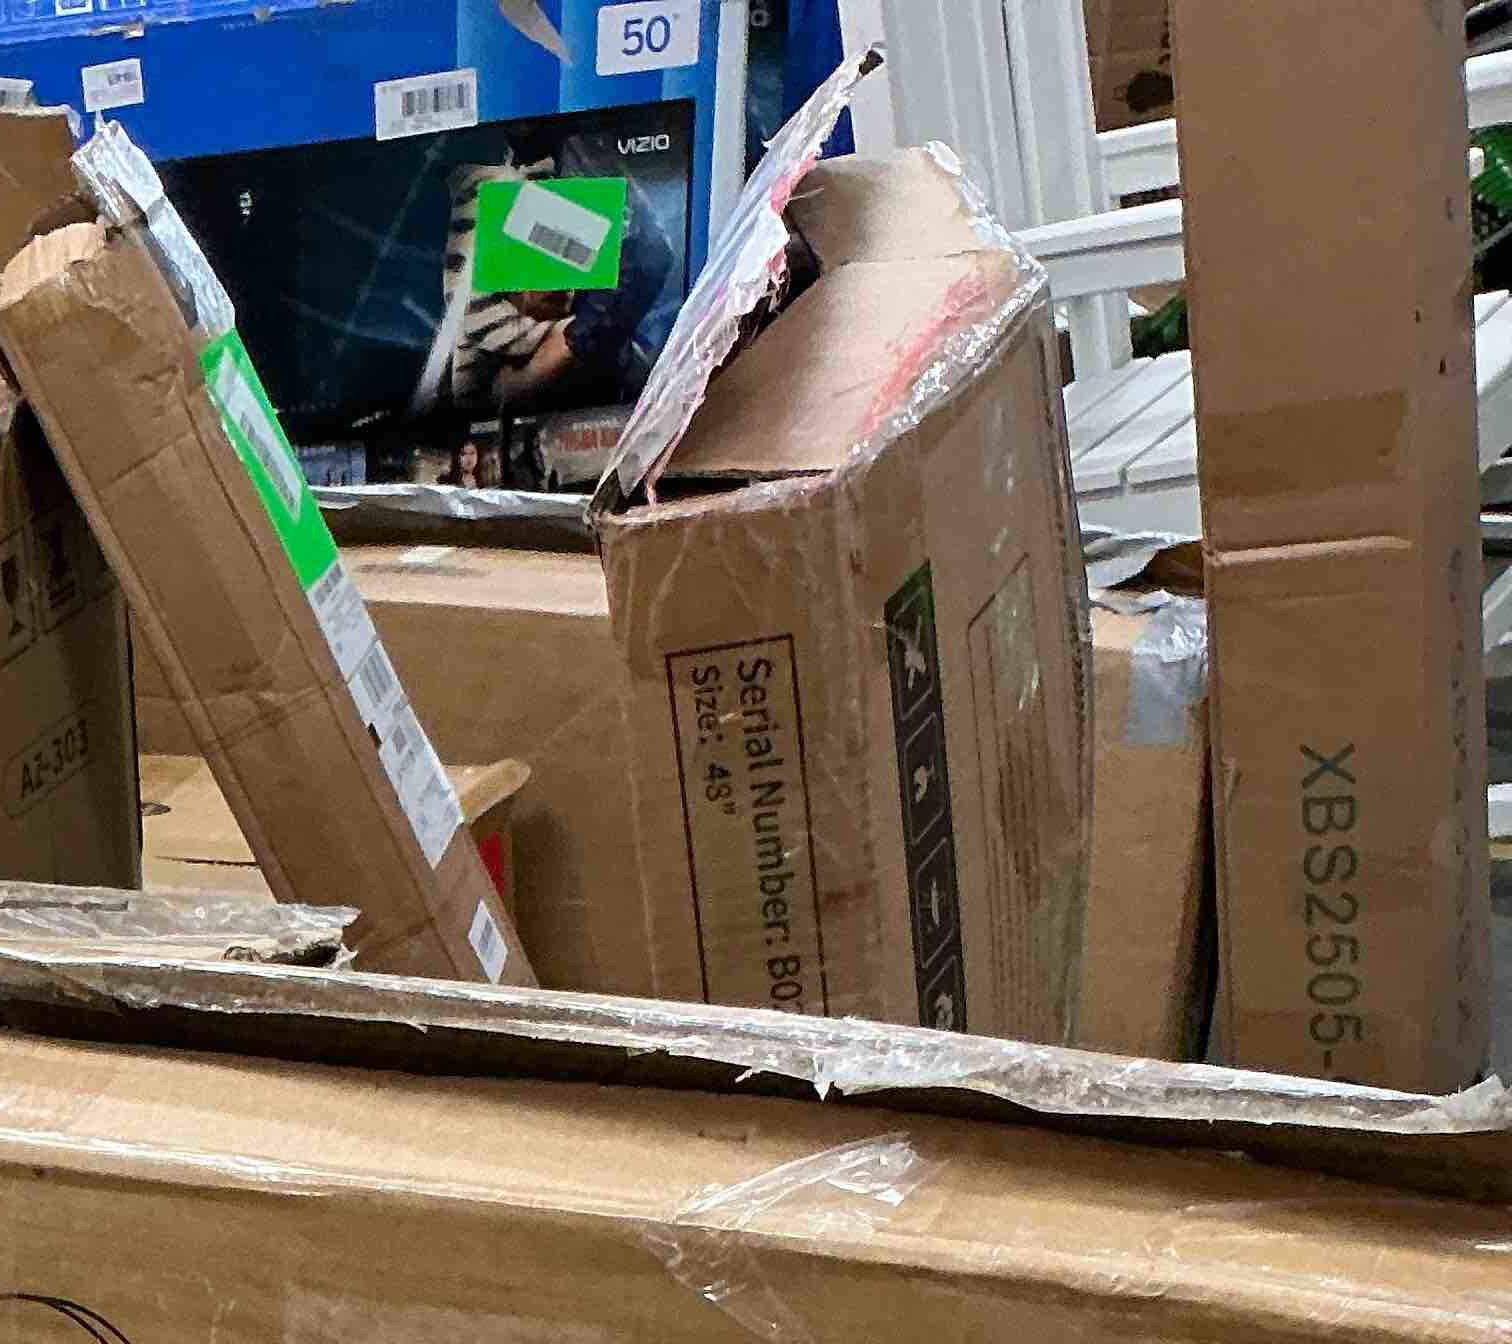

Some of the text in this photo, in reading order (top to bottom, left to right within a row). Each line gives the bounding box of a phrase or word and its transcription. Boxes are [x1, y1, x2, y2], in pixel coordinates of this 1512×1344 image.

[617, 133, 670, 155] VIZIO
[691, 665, 724, 744] Size:
[738, 658, 784, 772] Serial
[750, 781, 795, 946] Number:
